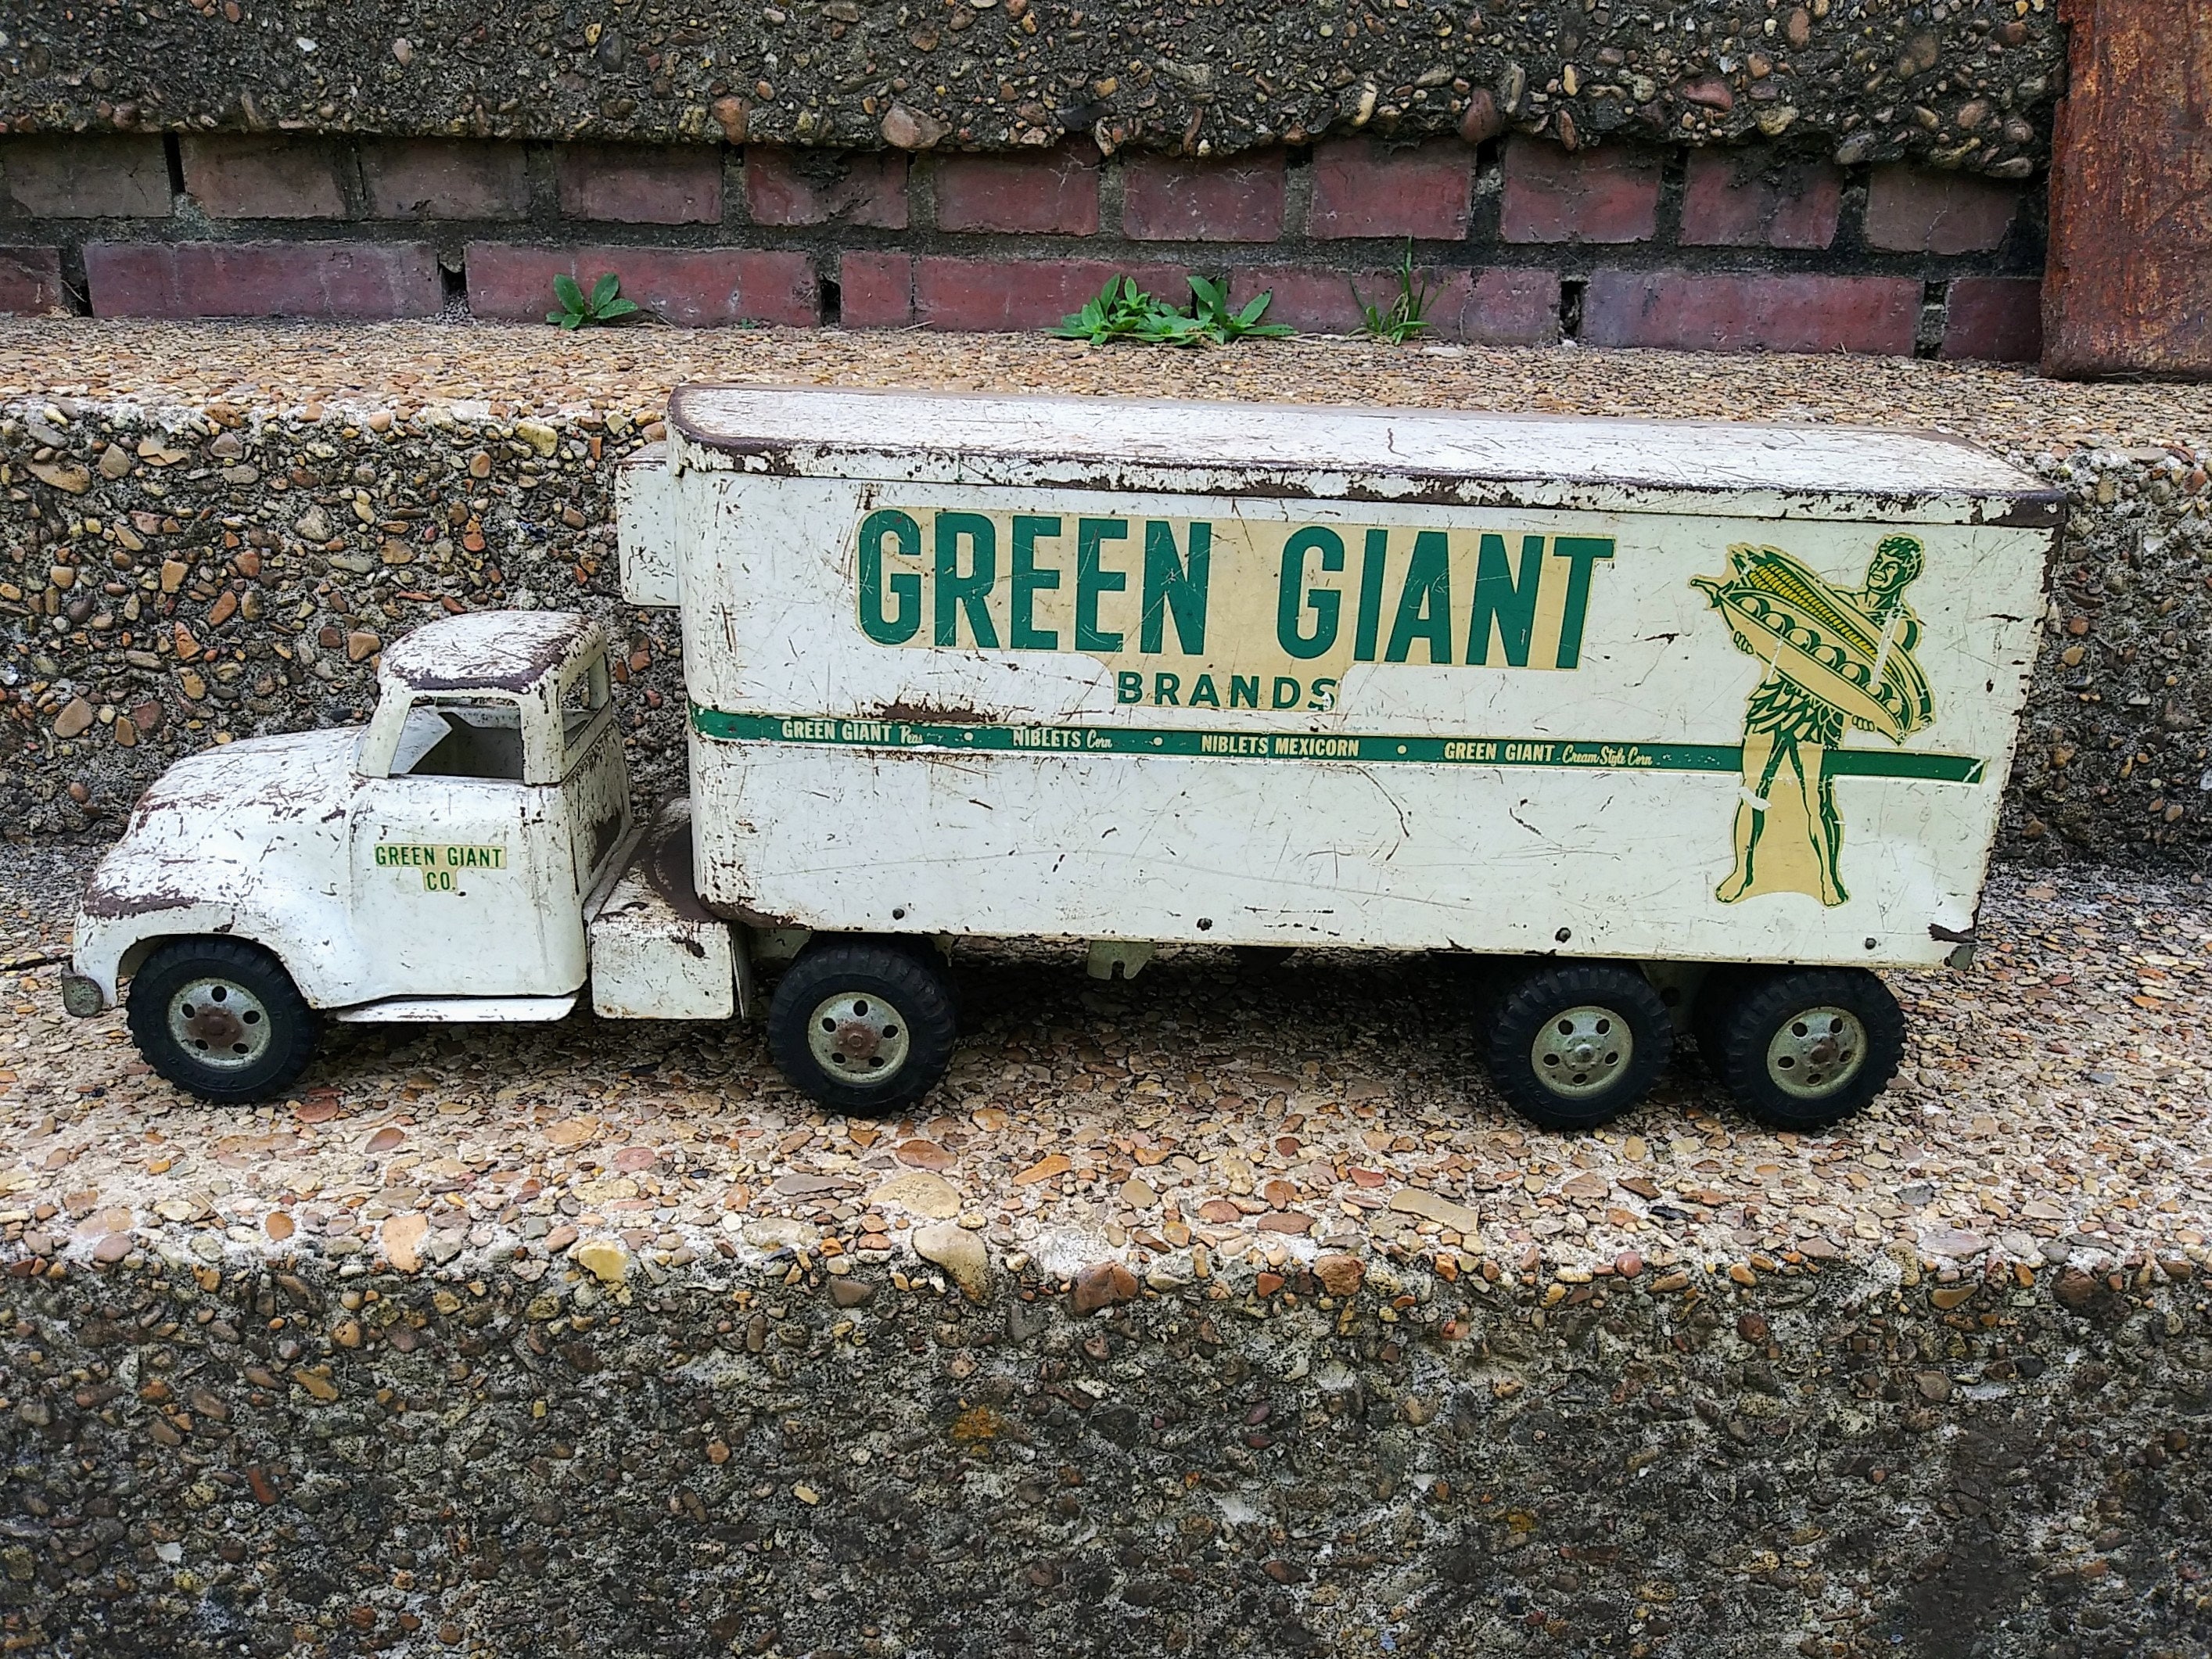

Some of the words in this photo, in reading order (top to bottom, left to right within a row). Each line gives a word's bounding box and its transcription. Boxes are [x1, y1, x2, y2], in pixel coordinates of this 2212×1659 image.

[860, 509, 1212, 655] GREEN
[1277, 526, 1615, 670] GIANT
[1117, 671, 1338, 711] BRANDS
[782, 720, 835, 741] GREEN
[842, 723, 892, 743] GIANT
[899, 725, 924, 745] Peas
[1013, 729, 1082, 749] NIBLETS
[1086, 729, 1113, 749] Corn
[1201, 734, 1269, 754] NIBLETS
[1274, 738, 1359, 757] MEXICORN
[1444, 742, 1497, 760] GREEN
[1505, 743, 1556, 762] GIANT
[1562, 744, 1600, 764] Cream
[1600, 745, 1626, 766] Style
[1627, 746, 1653, 767] Corn
[375, 846, 436, 866] GREEN
[447, 847, 502, 868] GIANT
[426, 871, 456, 891] CO.
